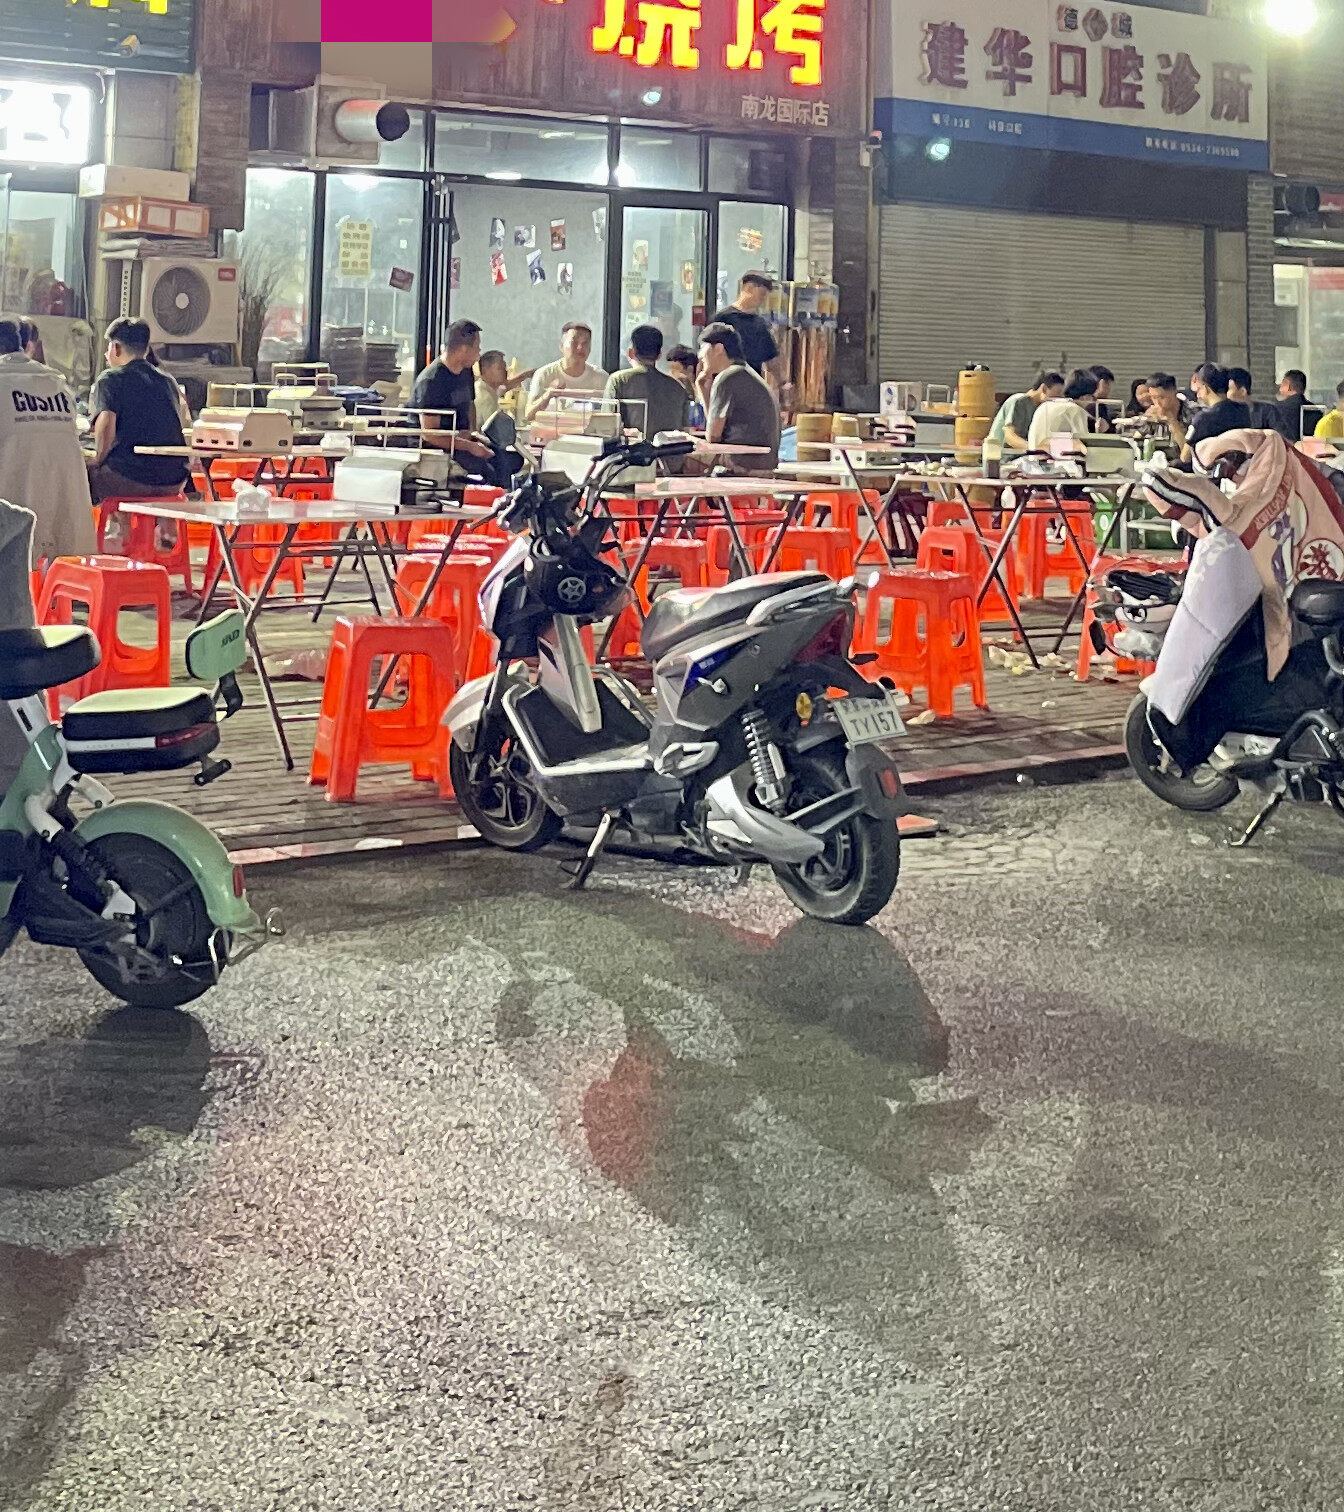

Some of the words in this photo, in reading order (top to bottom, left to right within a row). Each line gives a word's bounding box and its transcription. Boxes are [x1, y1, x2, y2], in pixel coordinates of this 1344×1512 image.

[920, 21, 1253, 123] 建华口腔诊所
[740, 94, 831, 127] 南龙国际店
[849, 710, 899, 737] TY157
